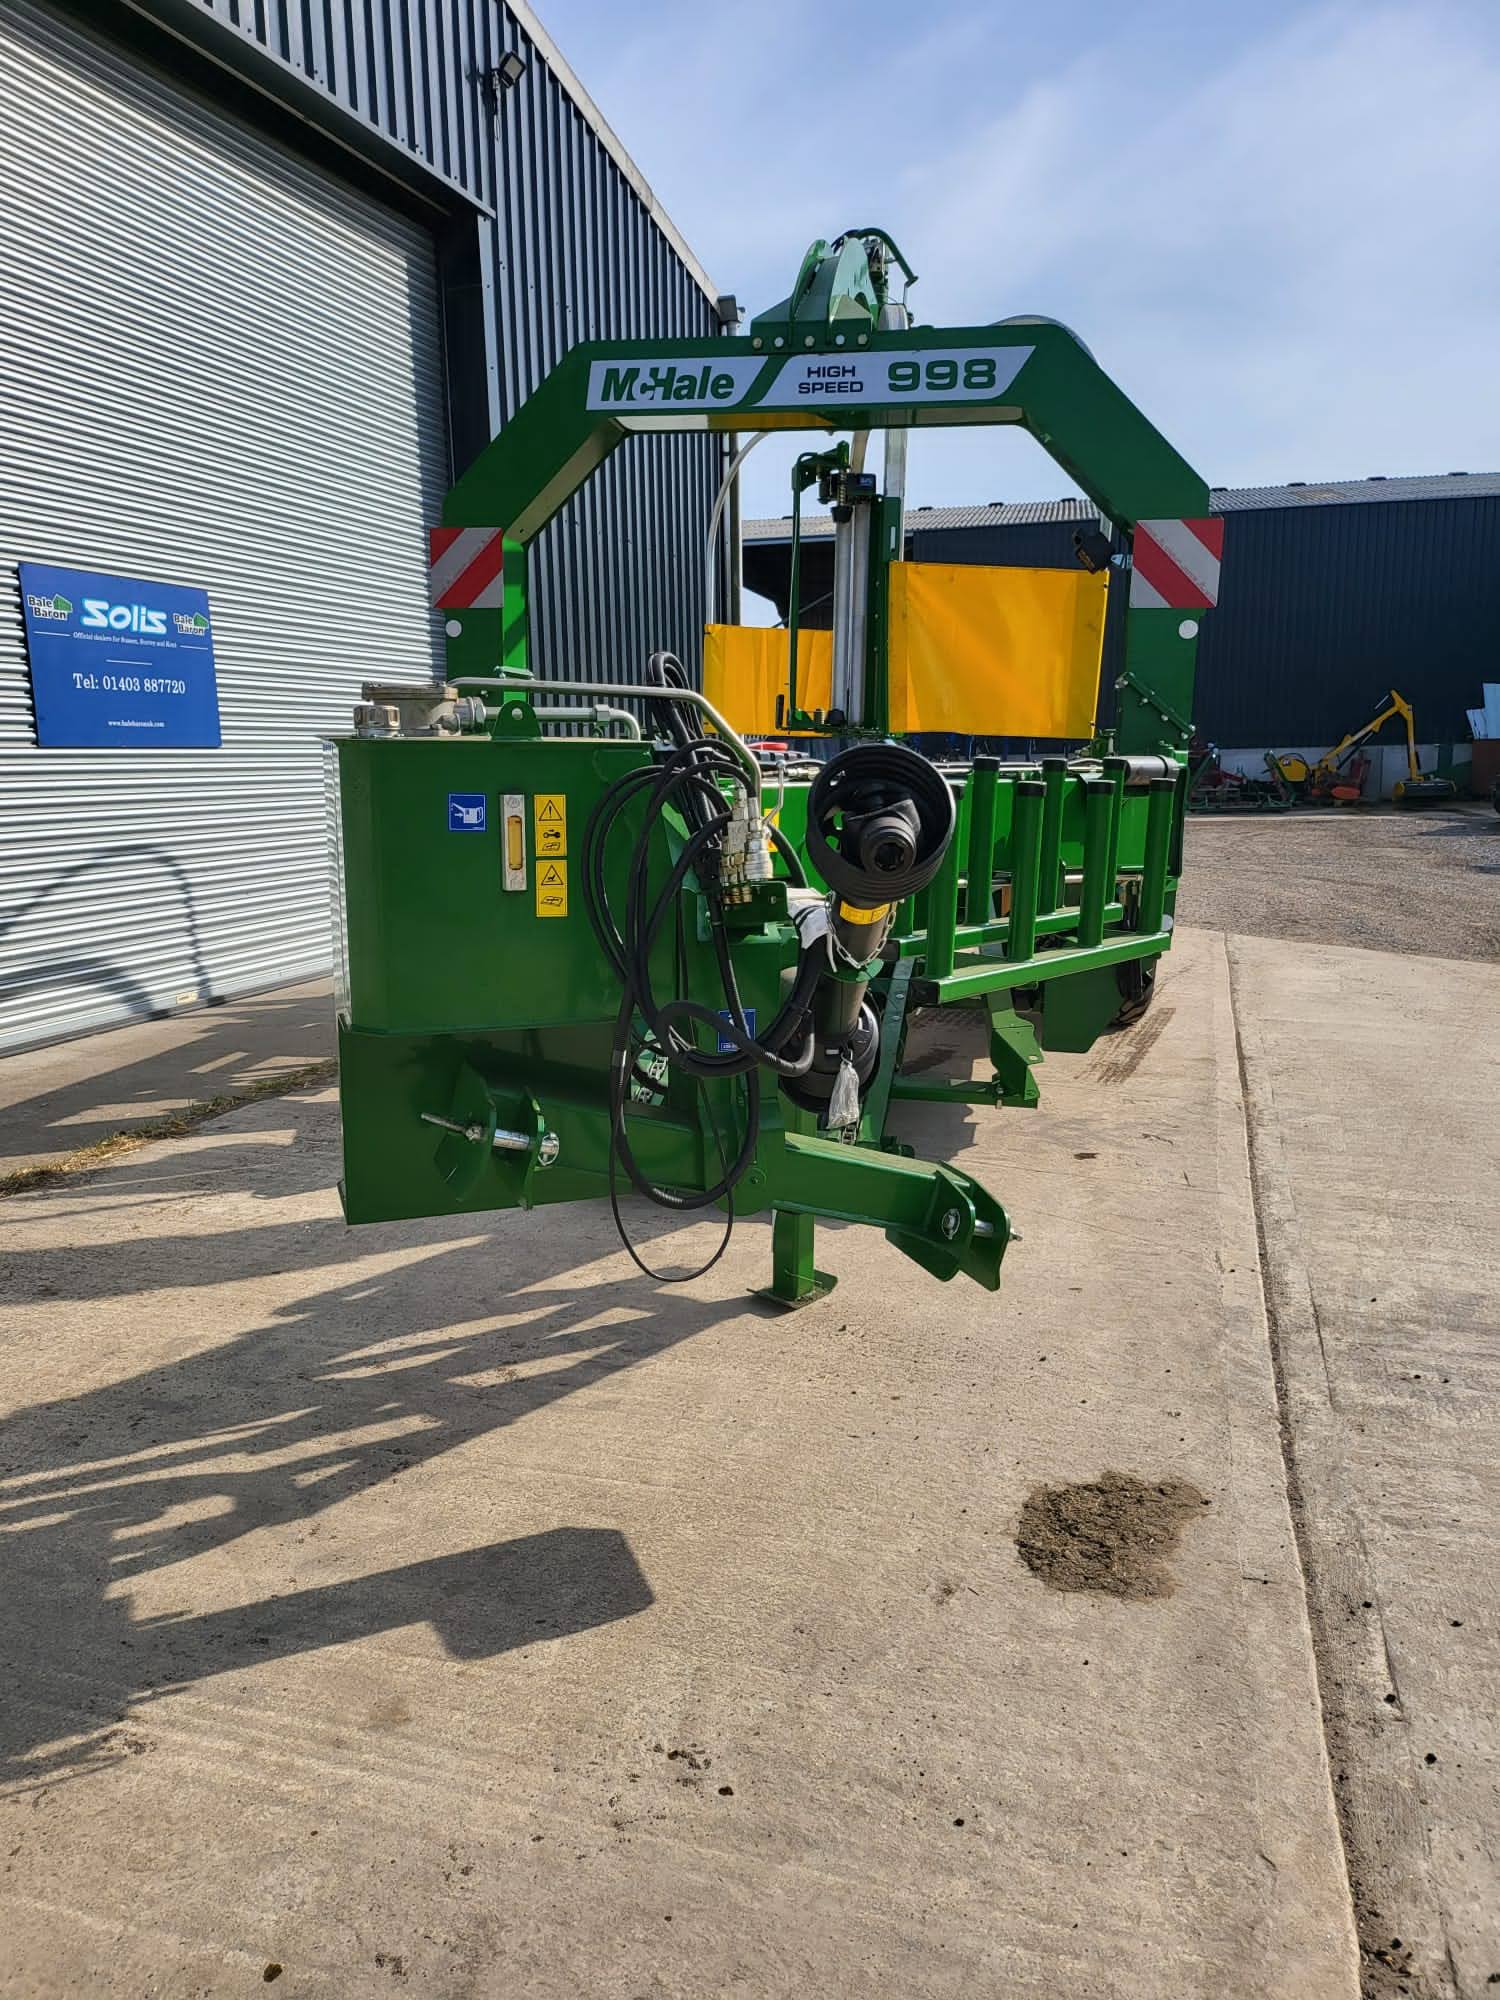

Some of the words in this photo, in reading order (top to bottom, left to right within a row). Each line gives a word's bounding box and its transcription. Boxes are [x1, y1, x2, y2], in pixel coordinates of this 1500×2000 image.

[806, 365, 857, 378] HIGH
[887, 359, 997, 393] 998
[600, 365, 736, 402] McHale
[798, 380, 864, 395] SPEED
[28, 595, 53, 609] Bale
[33, 607, 67, 620] Baron
[81, 598, 168, 635] Solis
[173, 613, 193, 626] Bale
[178, 623, 205, 636] Baron
[72, 673, 99, 690] Tel:
[103, 675, 140, 692] 01403
[144, 678, 186, 694] 887720
